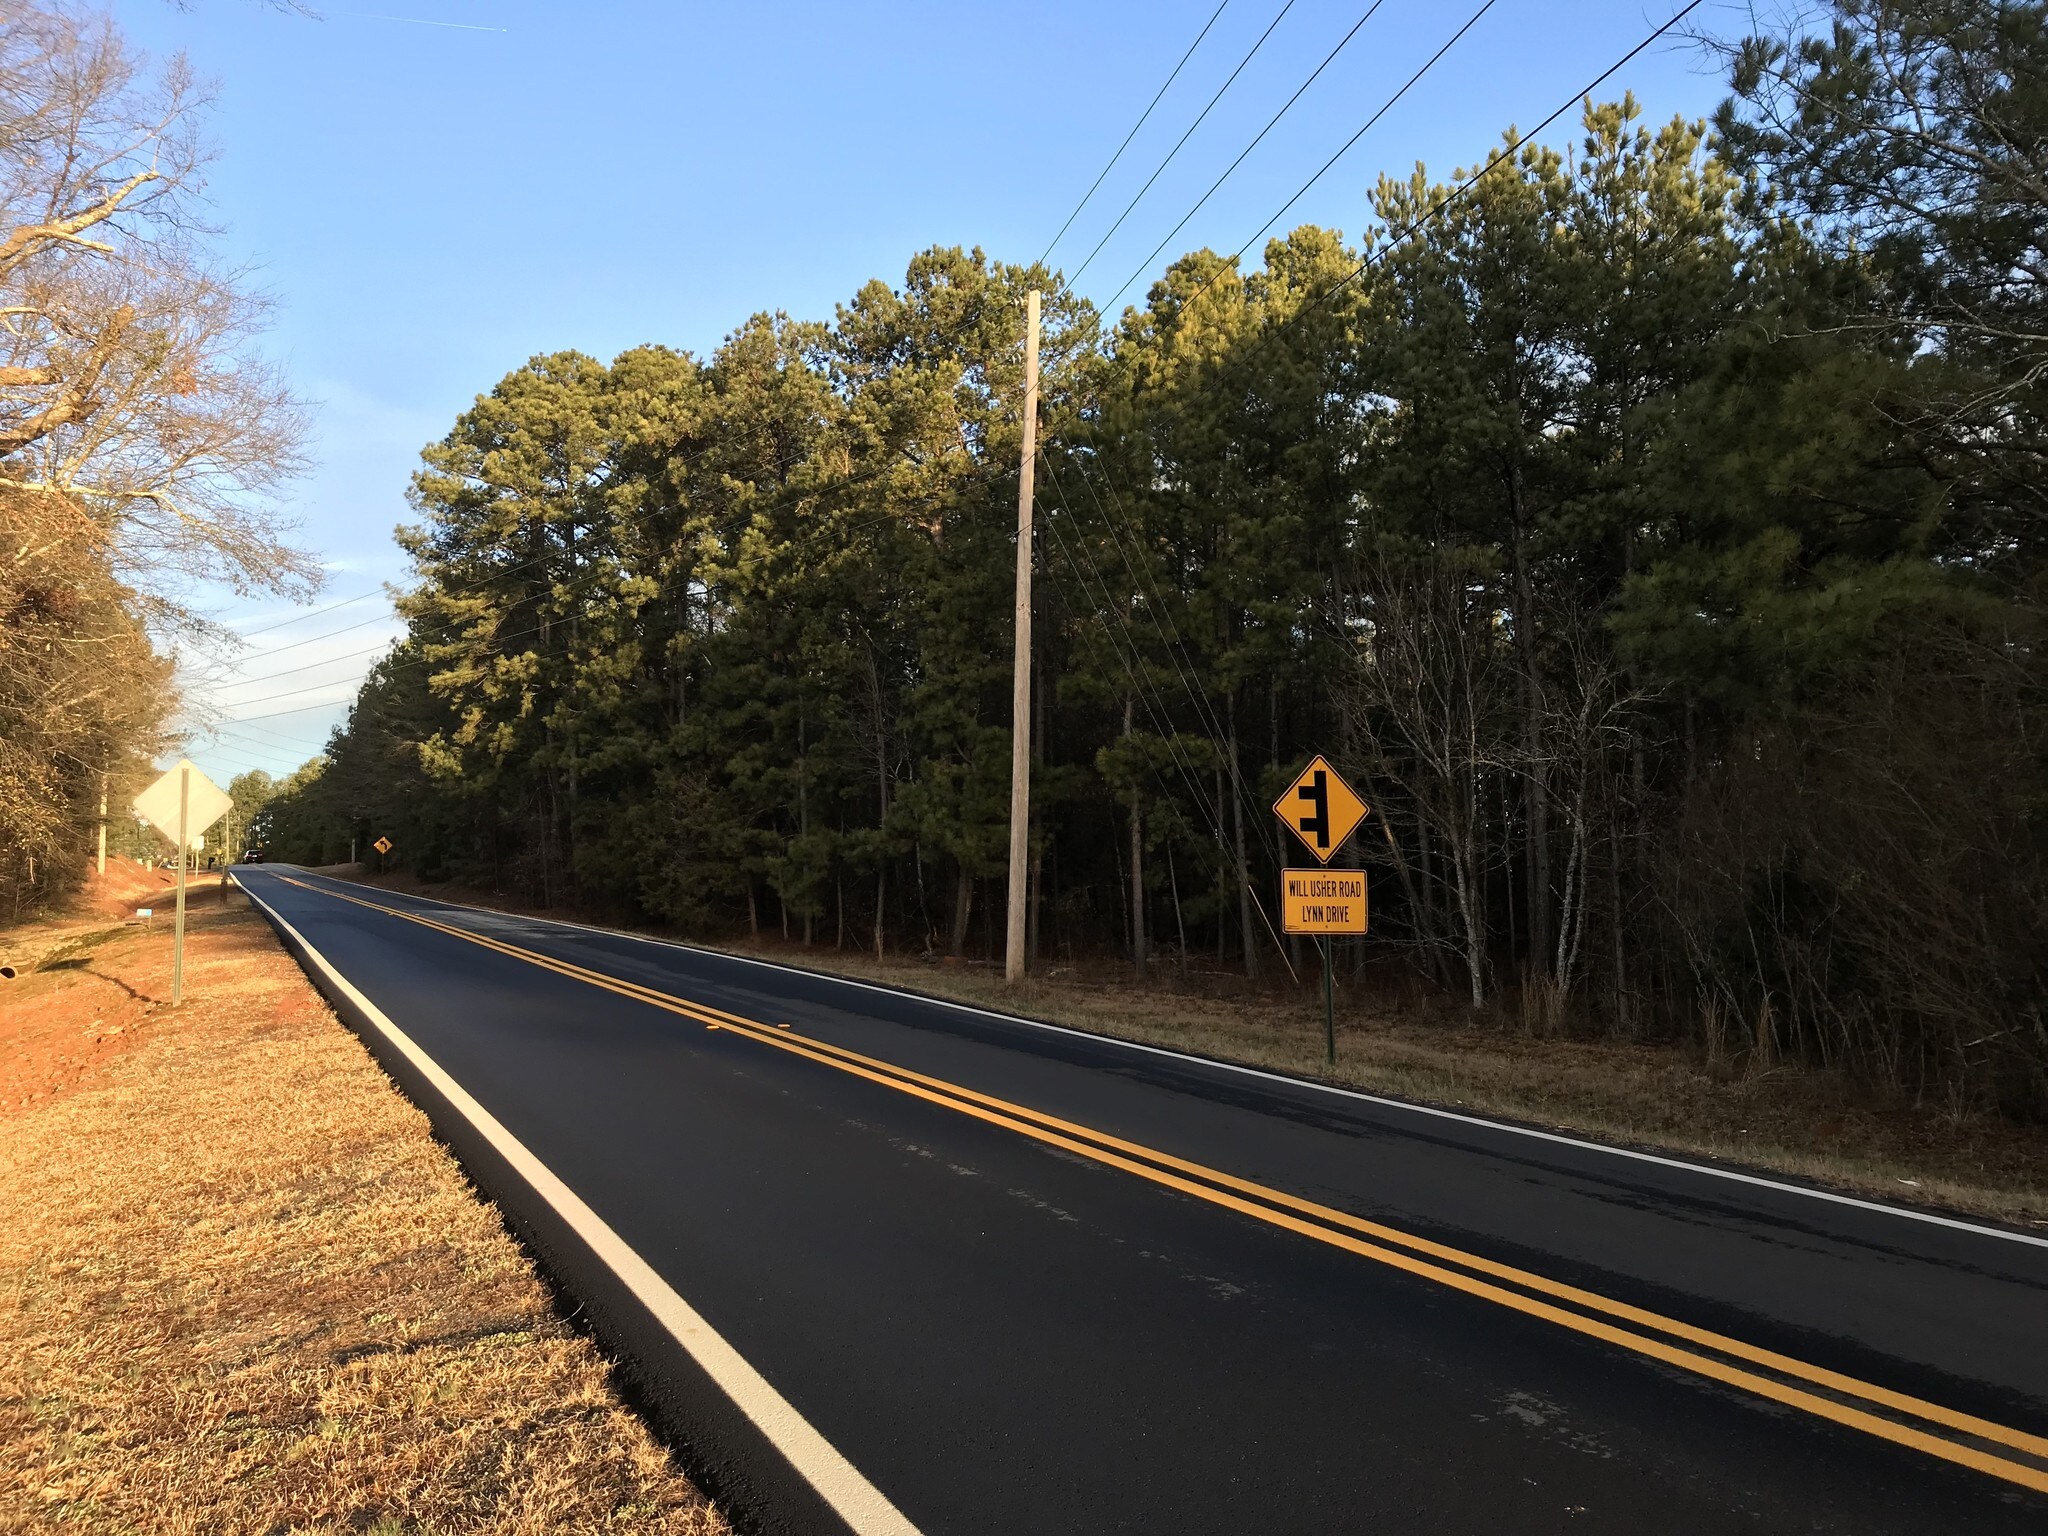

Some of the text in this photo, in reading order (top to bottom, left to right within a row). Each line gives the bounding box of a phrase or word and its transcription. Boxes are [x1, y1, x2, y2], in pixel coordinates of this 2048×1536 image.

[1289, 880, 1361, 897] WILL USHER ROAD
[1302, 906, 1349, 922] LYNN DRIVE
